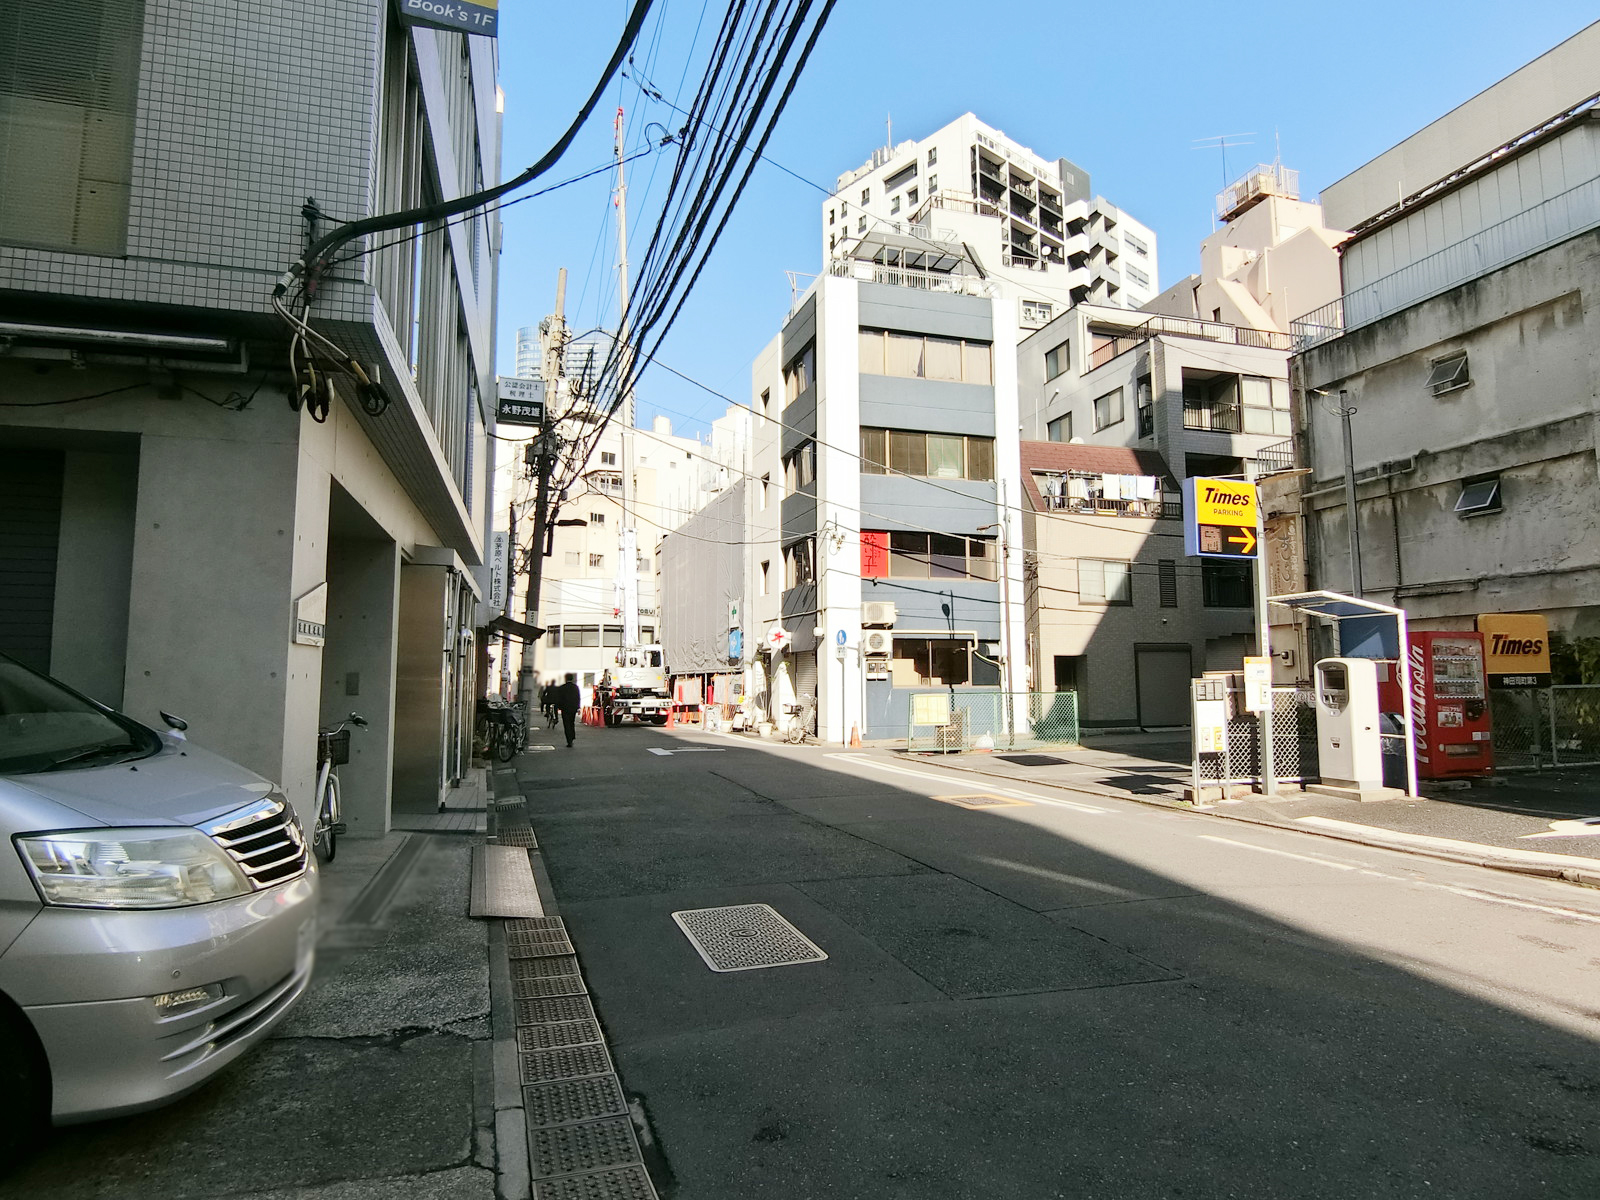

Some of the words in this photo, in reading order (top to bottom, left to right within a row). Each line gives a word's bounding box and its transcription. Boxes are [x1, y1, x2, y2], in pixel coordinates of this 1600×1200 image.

[407, 0, 469, 21] Book's
[473, 12, 494, 26] 1F
[1205, 487, 1250, 506] Times
[1213, 508, 1244, 517] PARKING
[1491, 633, 1543, 655] Times
